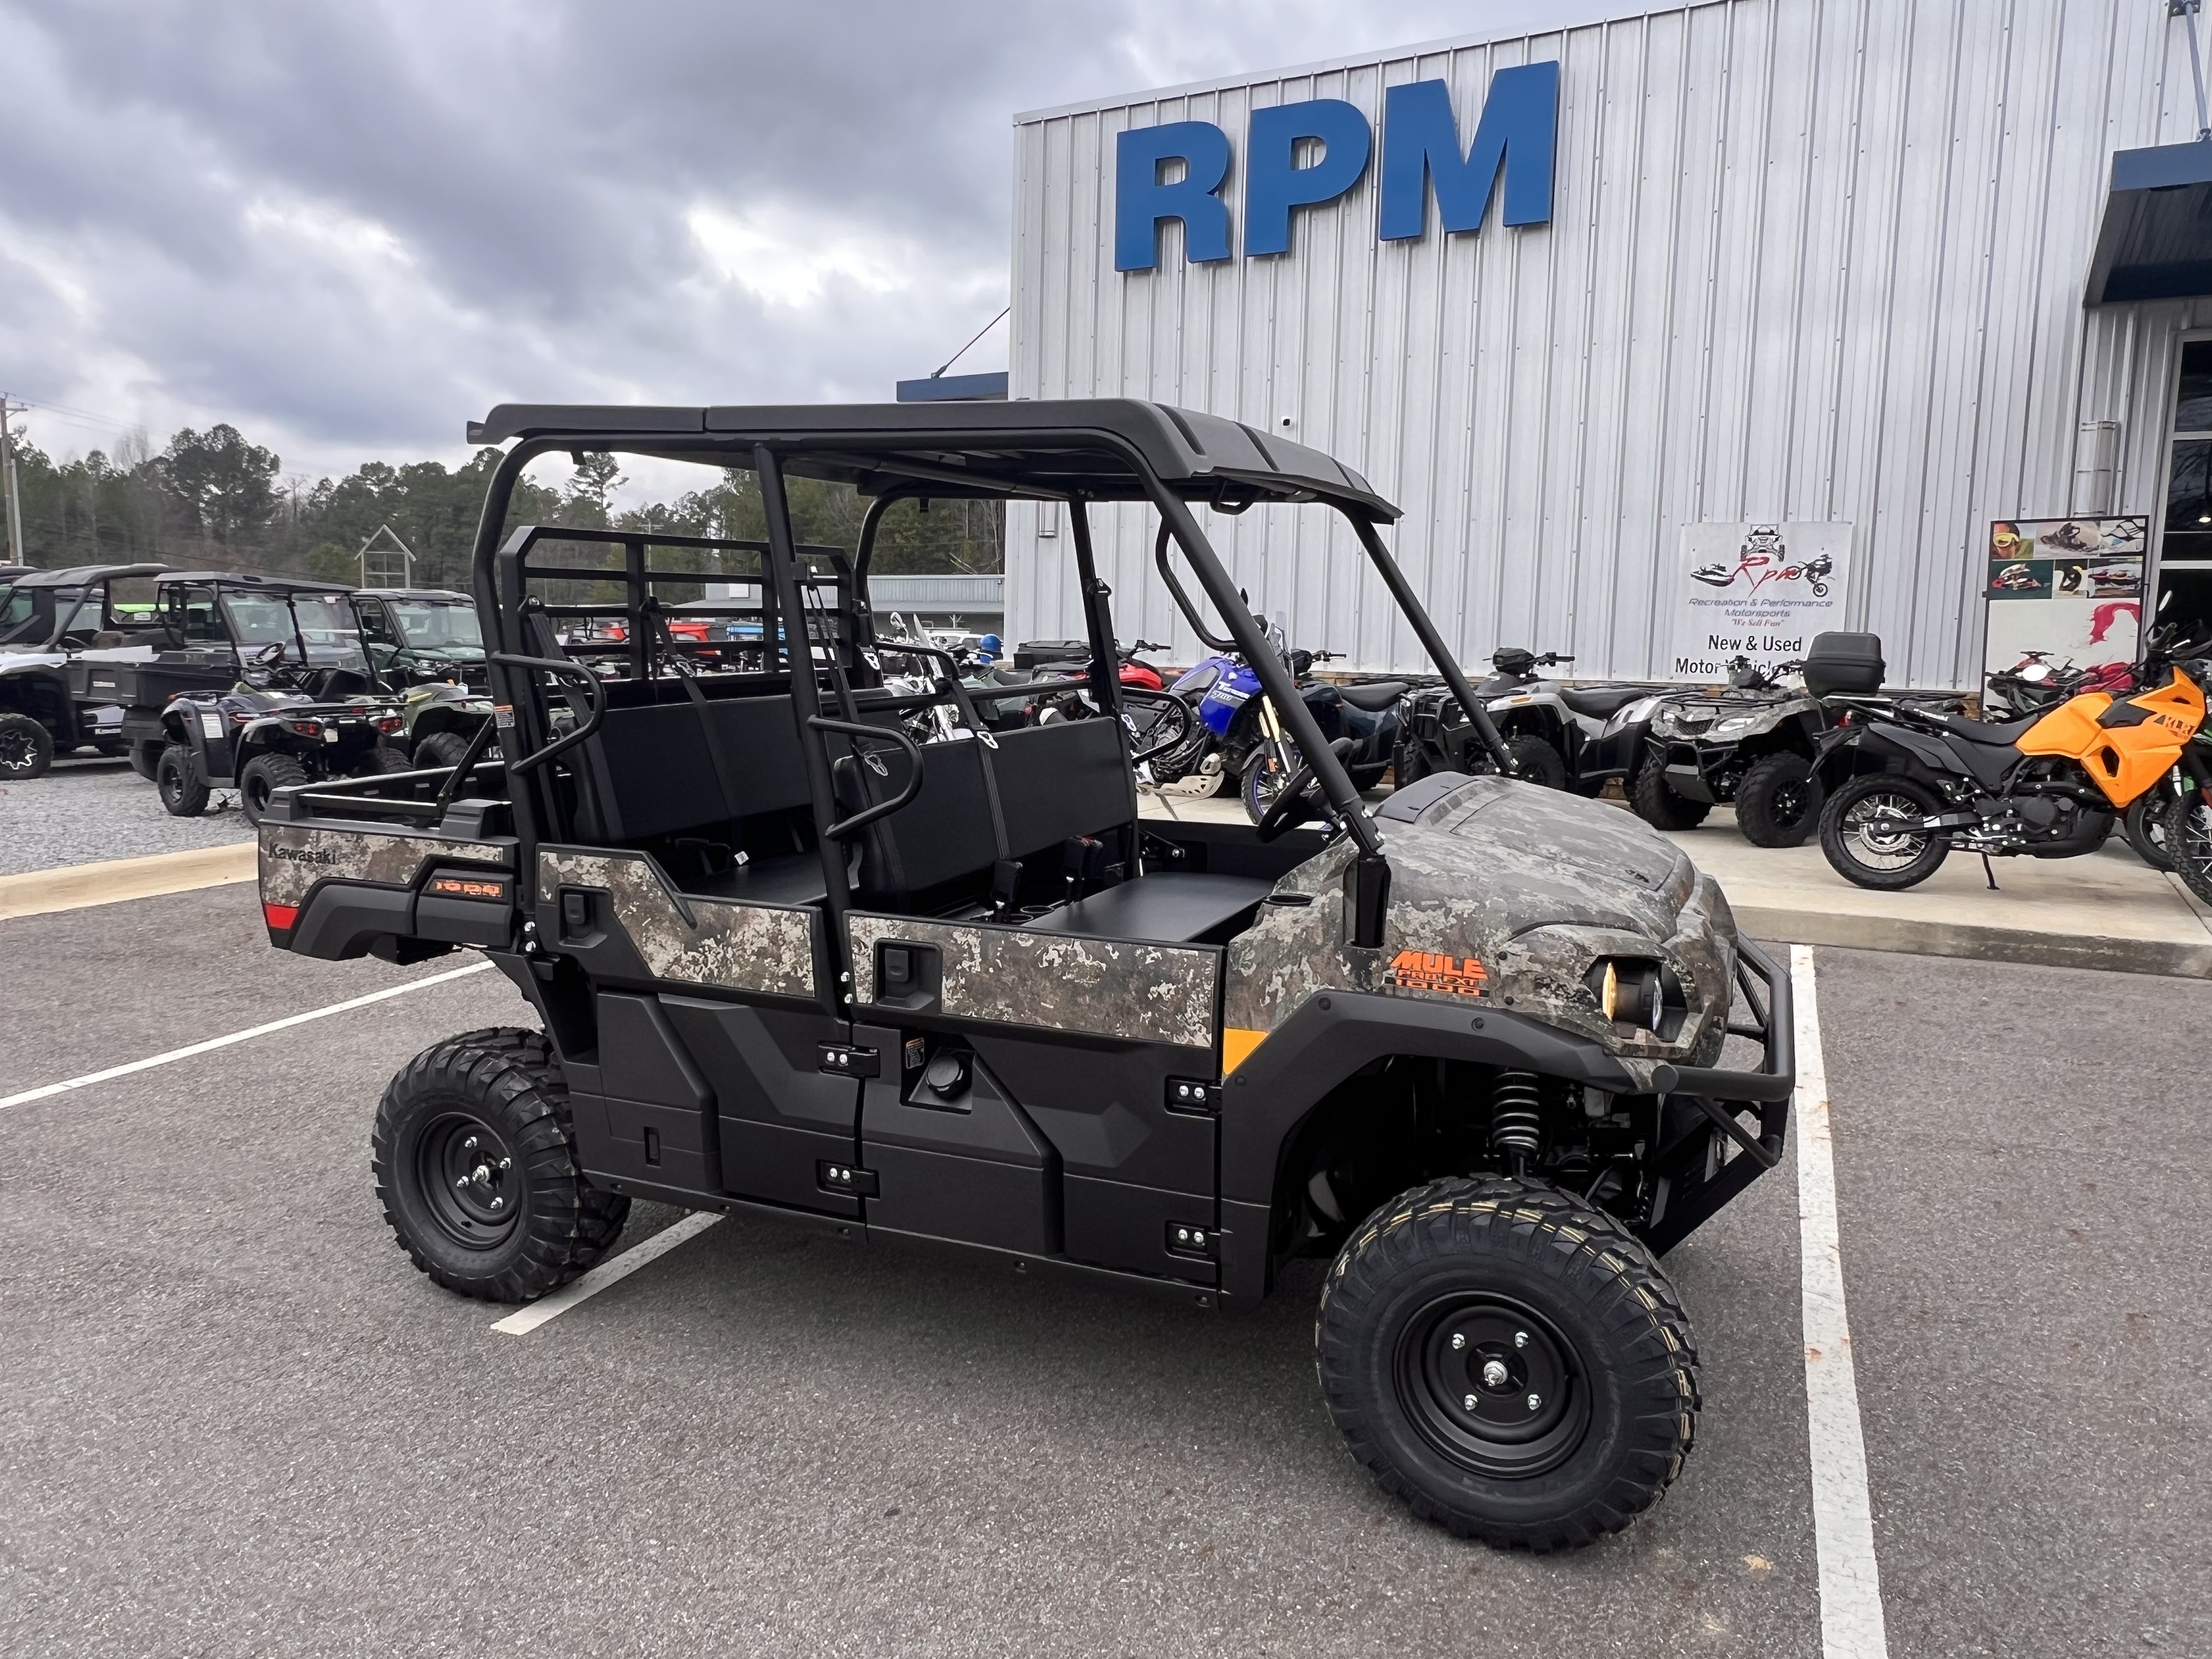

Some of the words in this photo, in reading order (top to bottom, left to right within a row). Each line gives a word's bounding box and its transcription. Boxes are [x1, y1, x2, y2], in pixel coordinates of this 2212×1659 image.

[1115, 60, 1559, 272] RPM
[1689, 598, 1747, 606] Recreation
[1725, 609, 1791, 617] Motorsports
[1708, 635, 1741, 650] New
[1746, 636, 1757, 651] &
[1763, 636, 1802, 652] Used
[1675, 658, 1719, 674] Motor
[269, 843, 336, 865] Kawasaki
[1390, 950, 1488, 980] MULE
